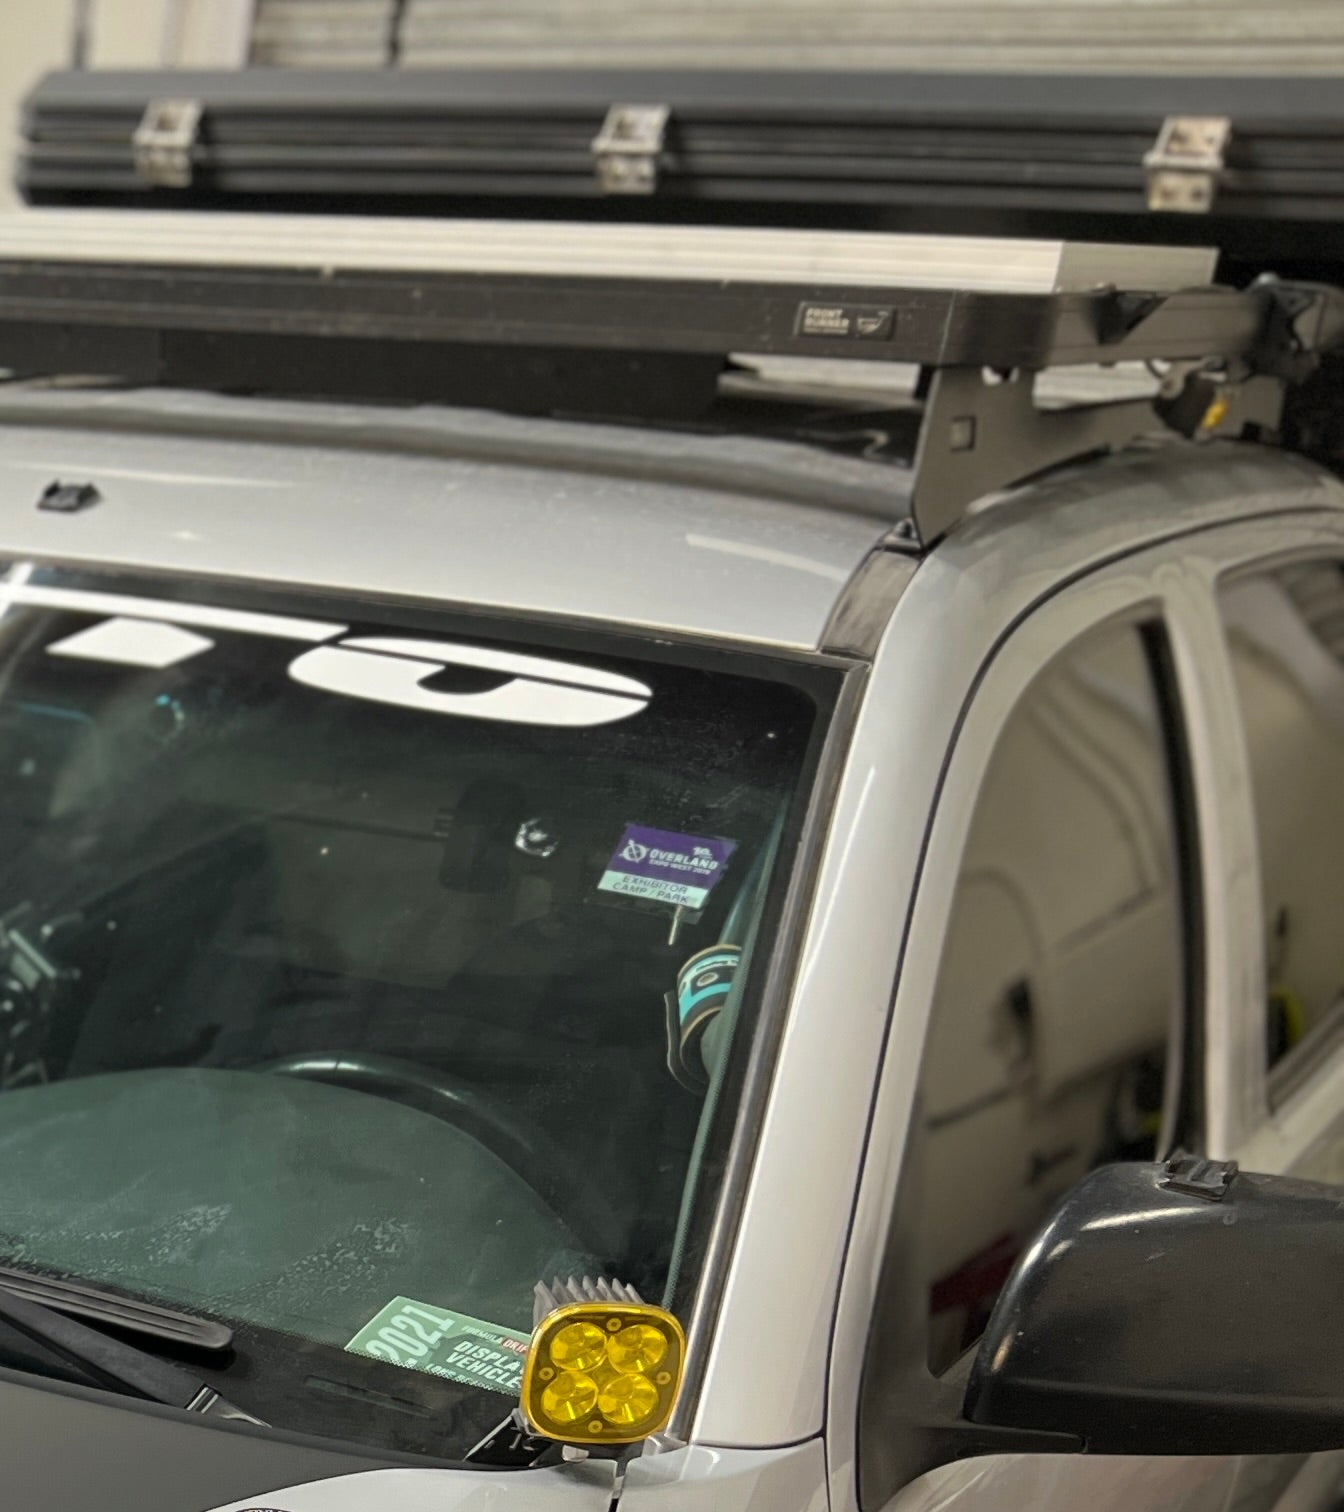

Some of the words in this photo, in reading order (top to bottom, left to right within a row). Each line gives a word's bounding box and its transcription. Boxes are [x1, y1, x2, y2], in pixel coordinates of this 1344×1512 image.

[649, 849, 719, 870] OVERLAND
[612, 882, 648, 895] CAMP
[657, 891, 690, 903] PARK
[622, 875, 688, 895] EXHIBITOR
[365, 1305, 456, 1369] 2021
[461, 1324, 504, 1345] FORMULA
[503, 1338, 529, 1354] DRIF
[454, 1341, 525, 1374] DISPLA
